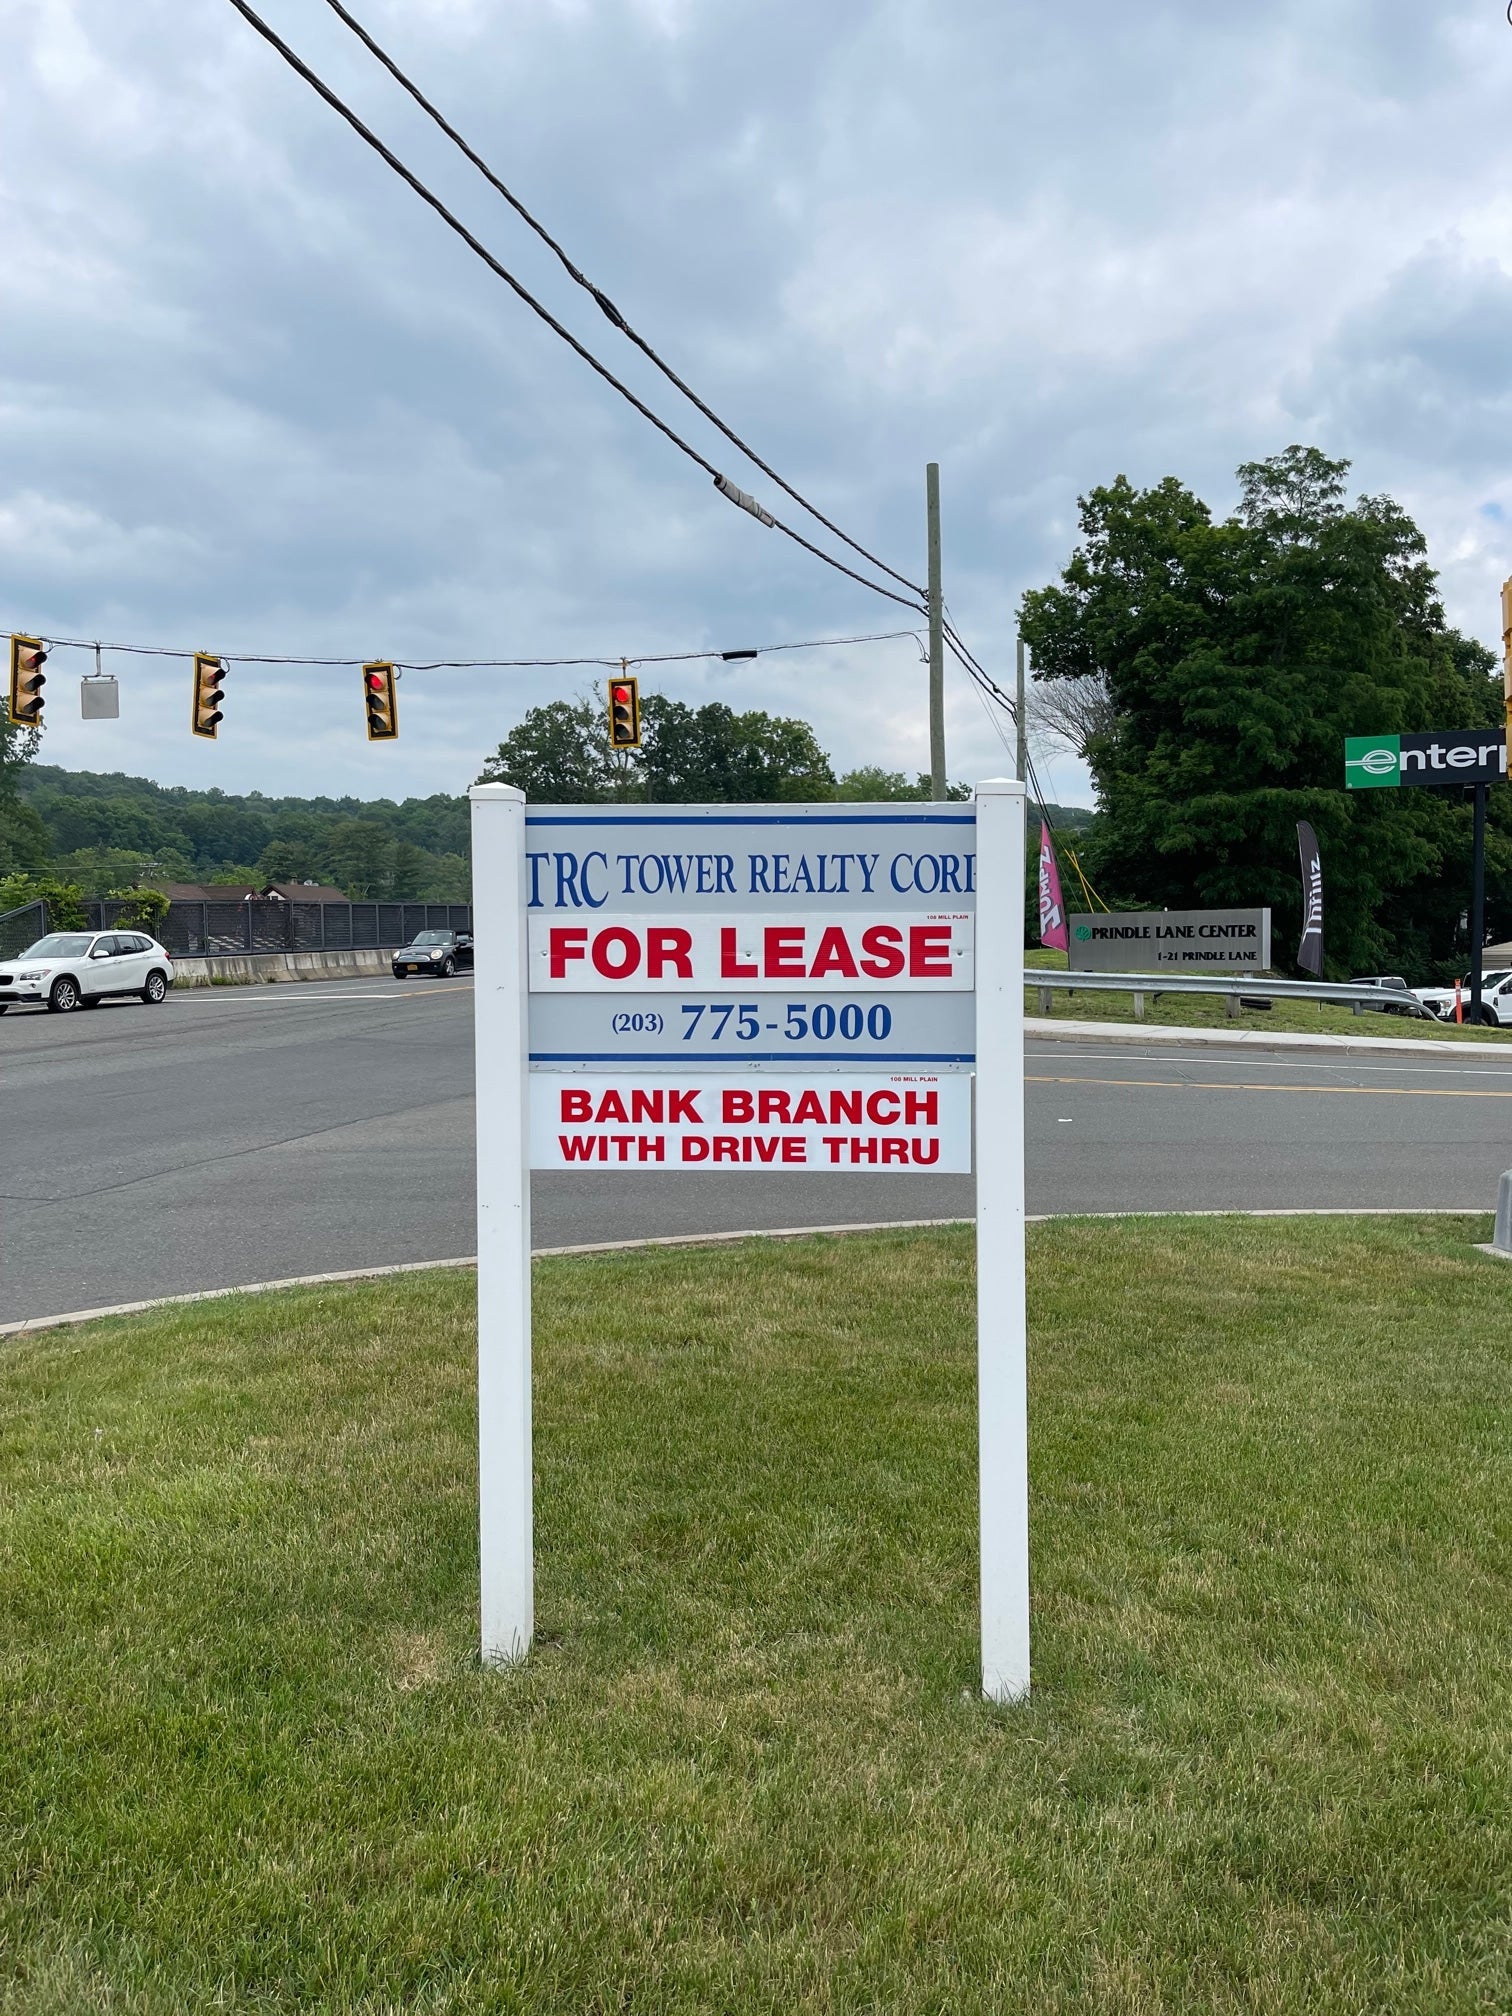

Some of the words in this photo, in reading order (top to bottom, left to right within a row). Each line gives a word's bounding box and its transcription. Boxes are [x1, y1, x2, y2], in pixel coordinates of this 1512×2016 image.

[1361, 744, 1507, 774] enter
[525, 851, 609, 908] TRC
[616, 854, 737, 894] TOWER
[748, 853, 880, 894] REALTY
[1092, 926, 1151, 940] PRINDLE
[1155, 925, 1195, 939] LANE
[1198, 924, 1257, 938] CENTER
[549, 926, 694, 980] FOR
[720, 925, 953, 979] LEASE
[1157, 952, 1178, 961] 1-21
[1182, 952, 1225, 961] PRINDLE
[1228, 951, 1257, 961] LANE
[611, 1013, 664, 1035] (203)
[680, 1003, 893, 1041] 775-5000
[560, 1089, 704, 1124] BANK
[722, 1090, 939, 1125] BRANCH
[558, 1135, 665, 1162] WITH
[681, 1136, 807, 1163] DRIVE
[822, 1137, 940, 1164] THRU
